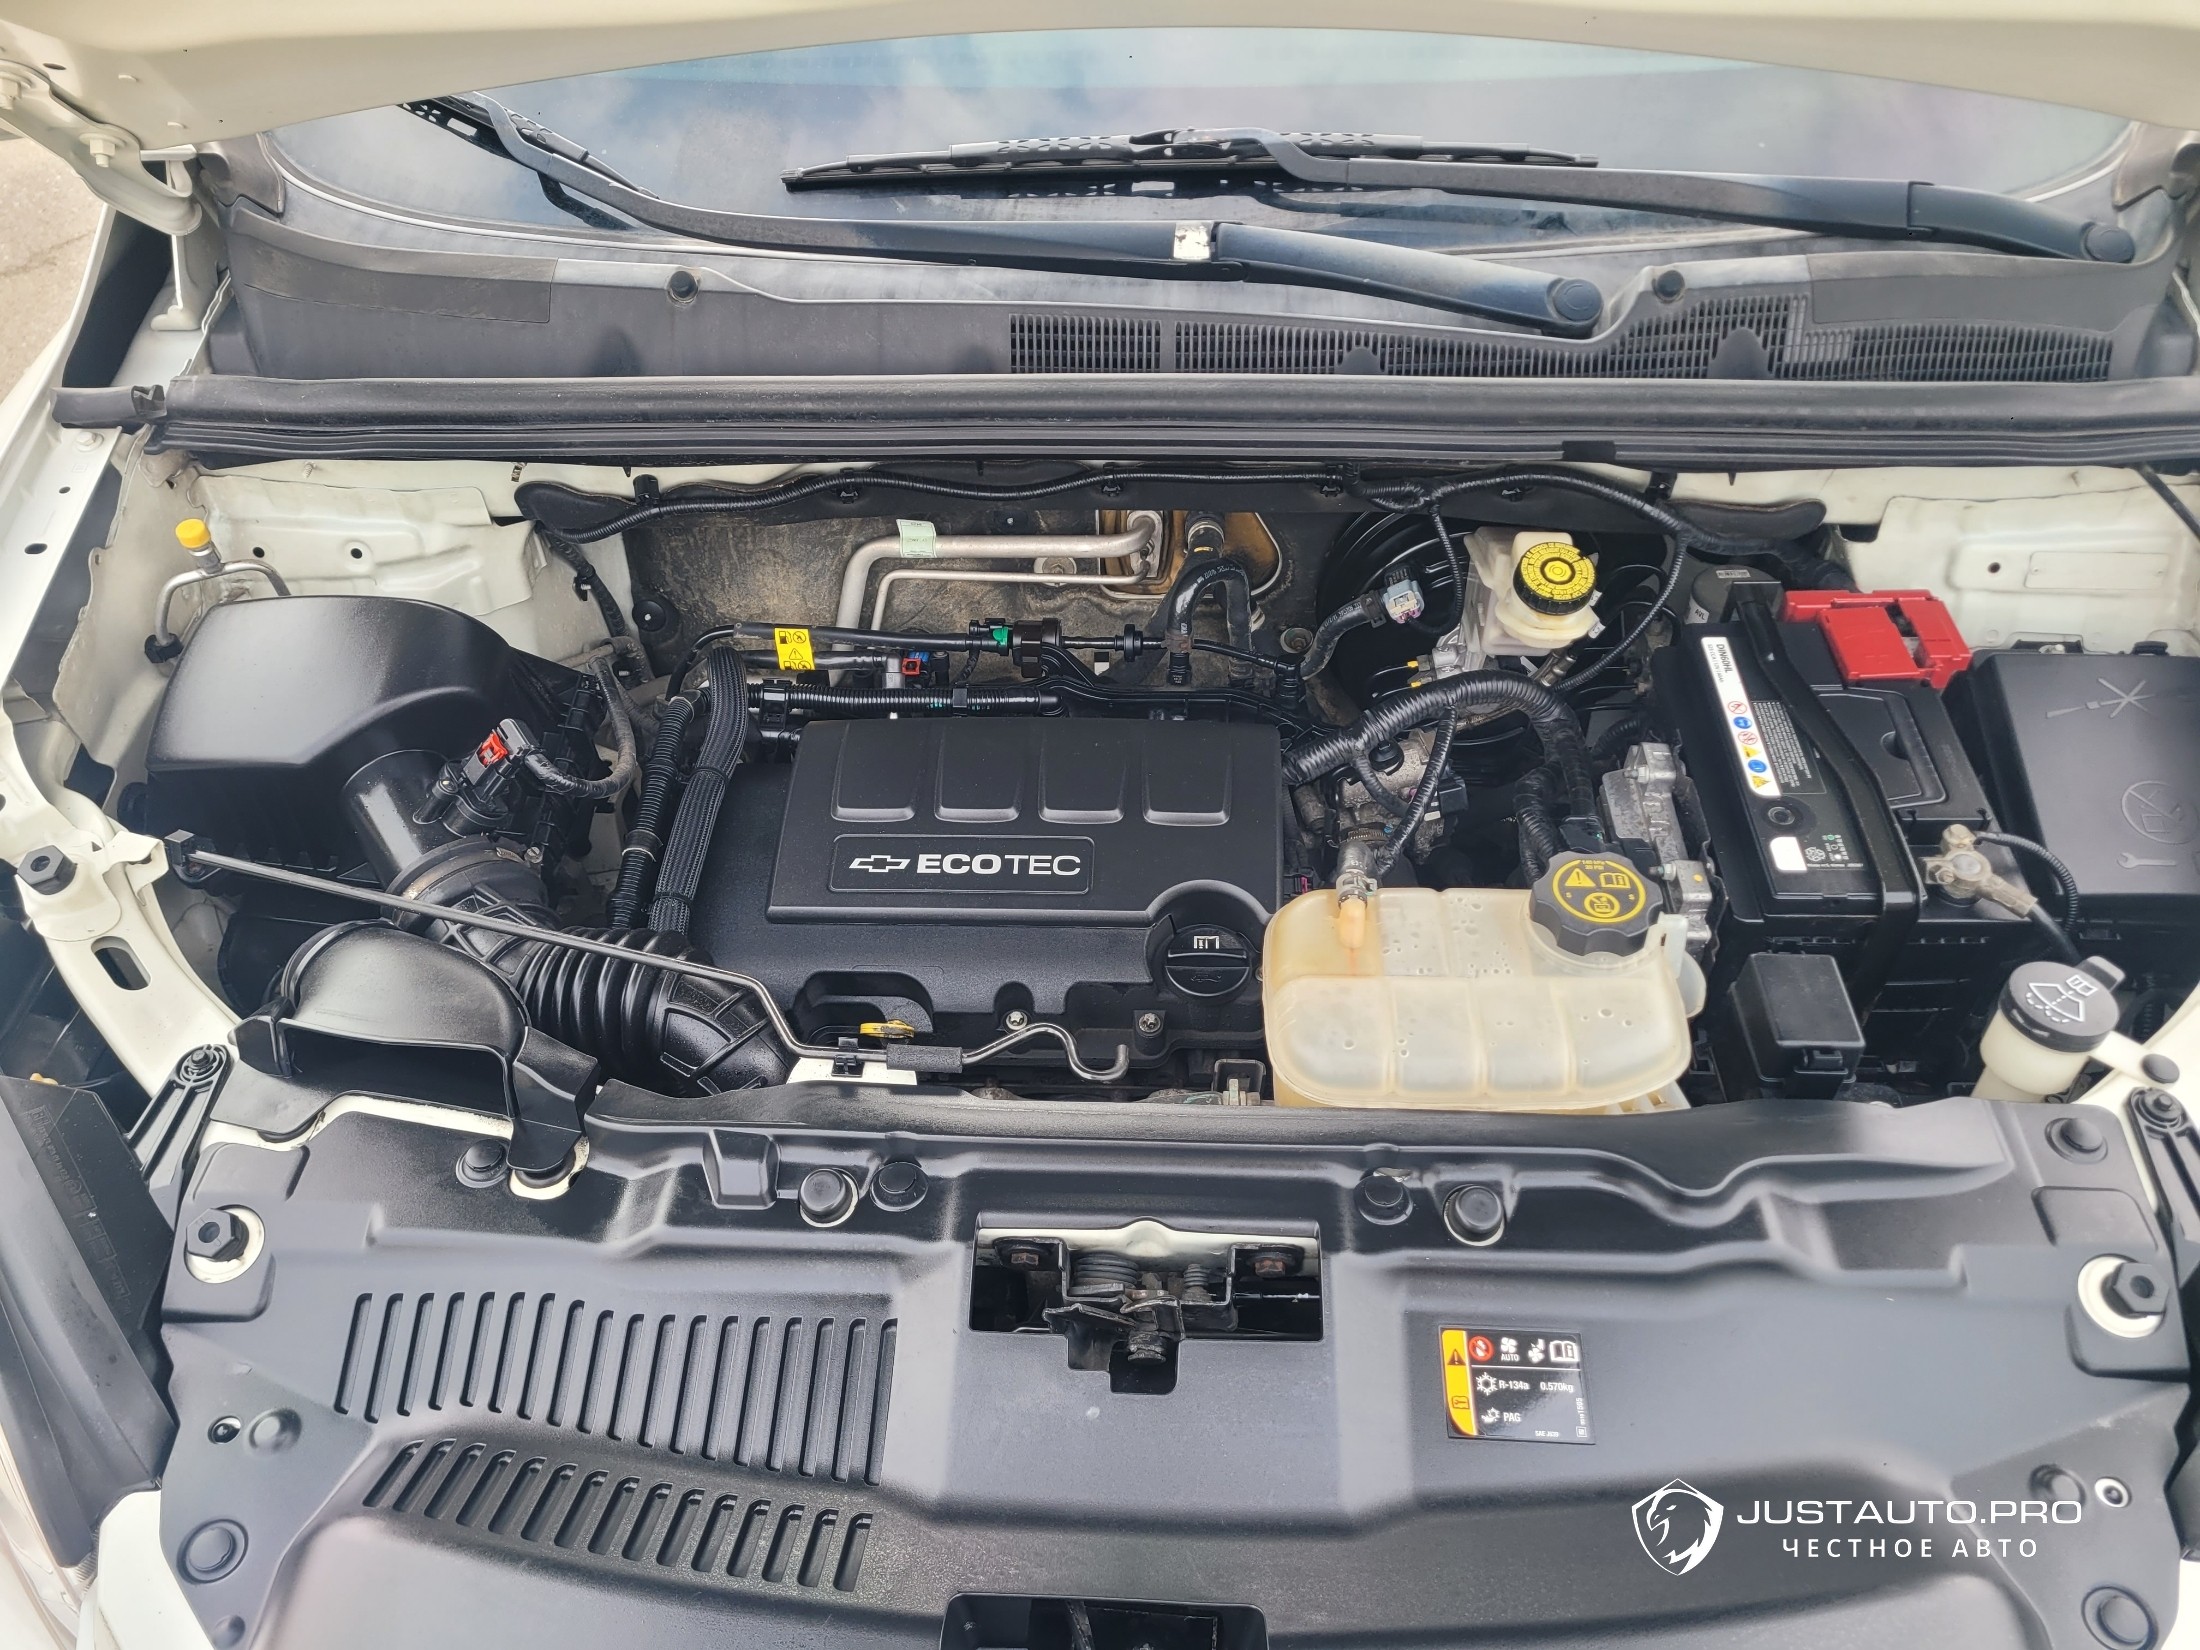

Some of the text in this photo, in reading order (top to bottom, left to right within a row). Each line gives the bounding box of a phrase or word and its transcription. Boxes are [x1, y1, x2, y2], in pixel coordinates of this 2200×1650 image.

[1716, 643, 1734, 674] DIN60HL
[916, 853, 1081, 876] ECOTEC
[1500, 1353, 1520, 1362] AUTO
[1498, 1380, 1574, 1393] R-134a 0.570kg
[1503, 1412, 1522, 1423] PAG
